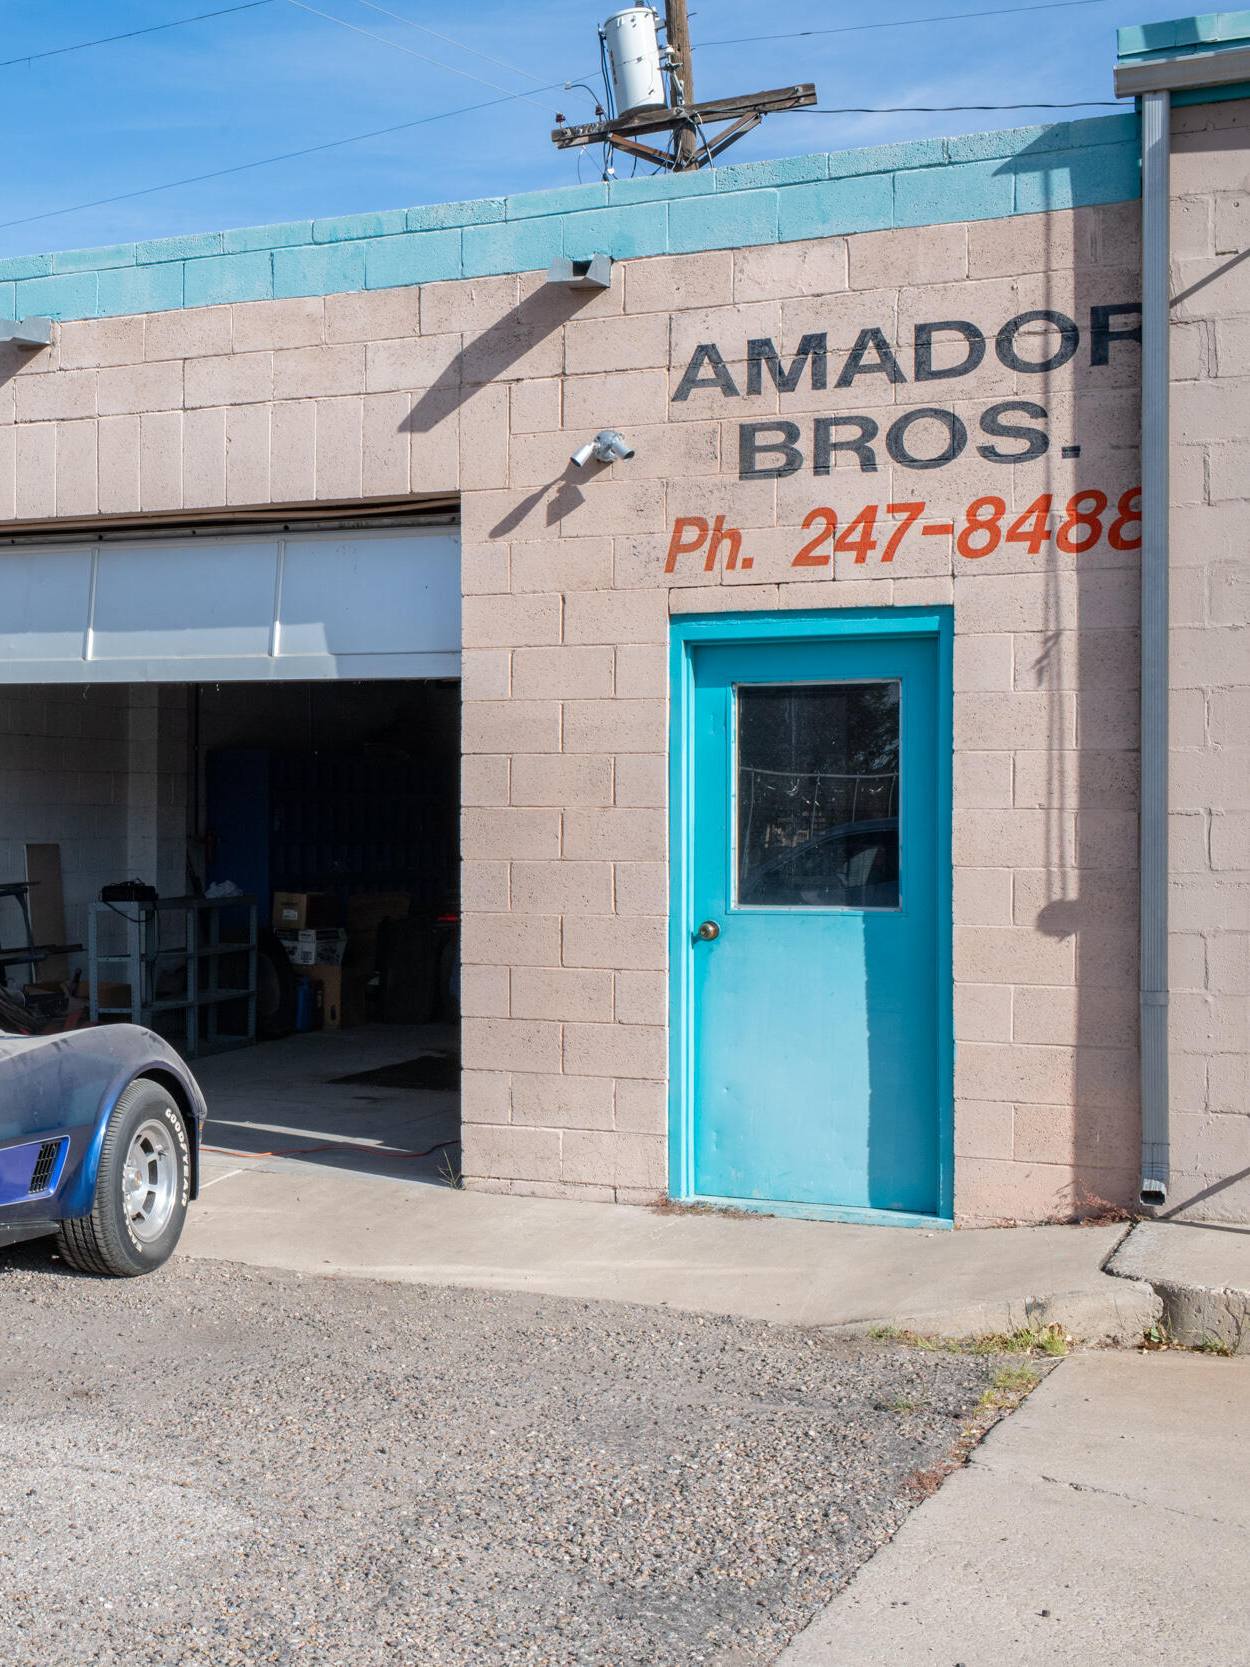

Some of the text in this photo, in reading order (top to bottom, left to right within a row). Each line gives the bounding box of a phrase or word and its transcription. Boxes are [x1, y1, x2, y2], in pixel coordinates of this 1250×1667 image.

[671, 302, 1142, 402] AMADOR
[738, 400, 1081, 481] BROS.
[664, 486, 1142, 574] Ph. 247-8488
[165, 1107, 189, 1207] GOODYEAR
